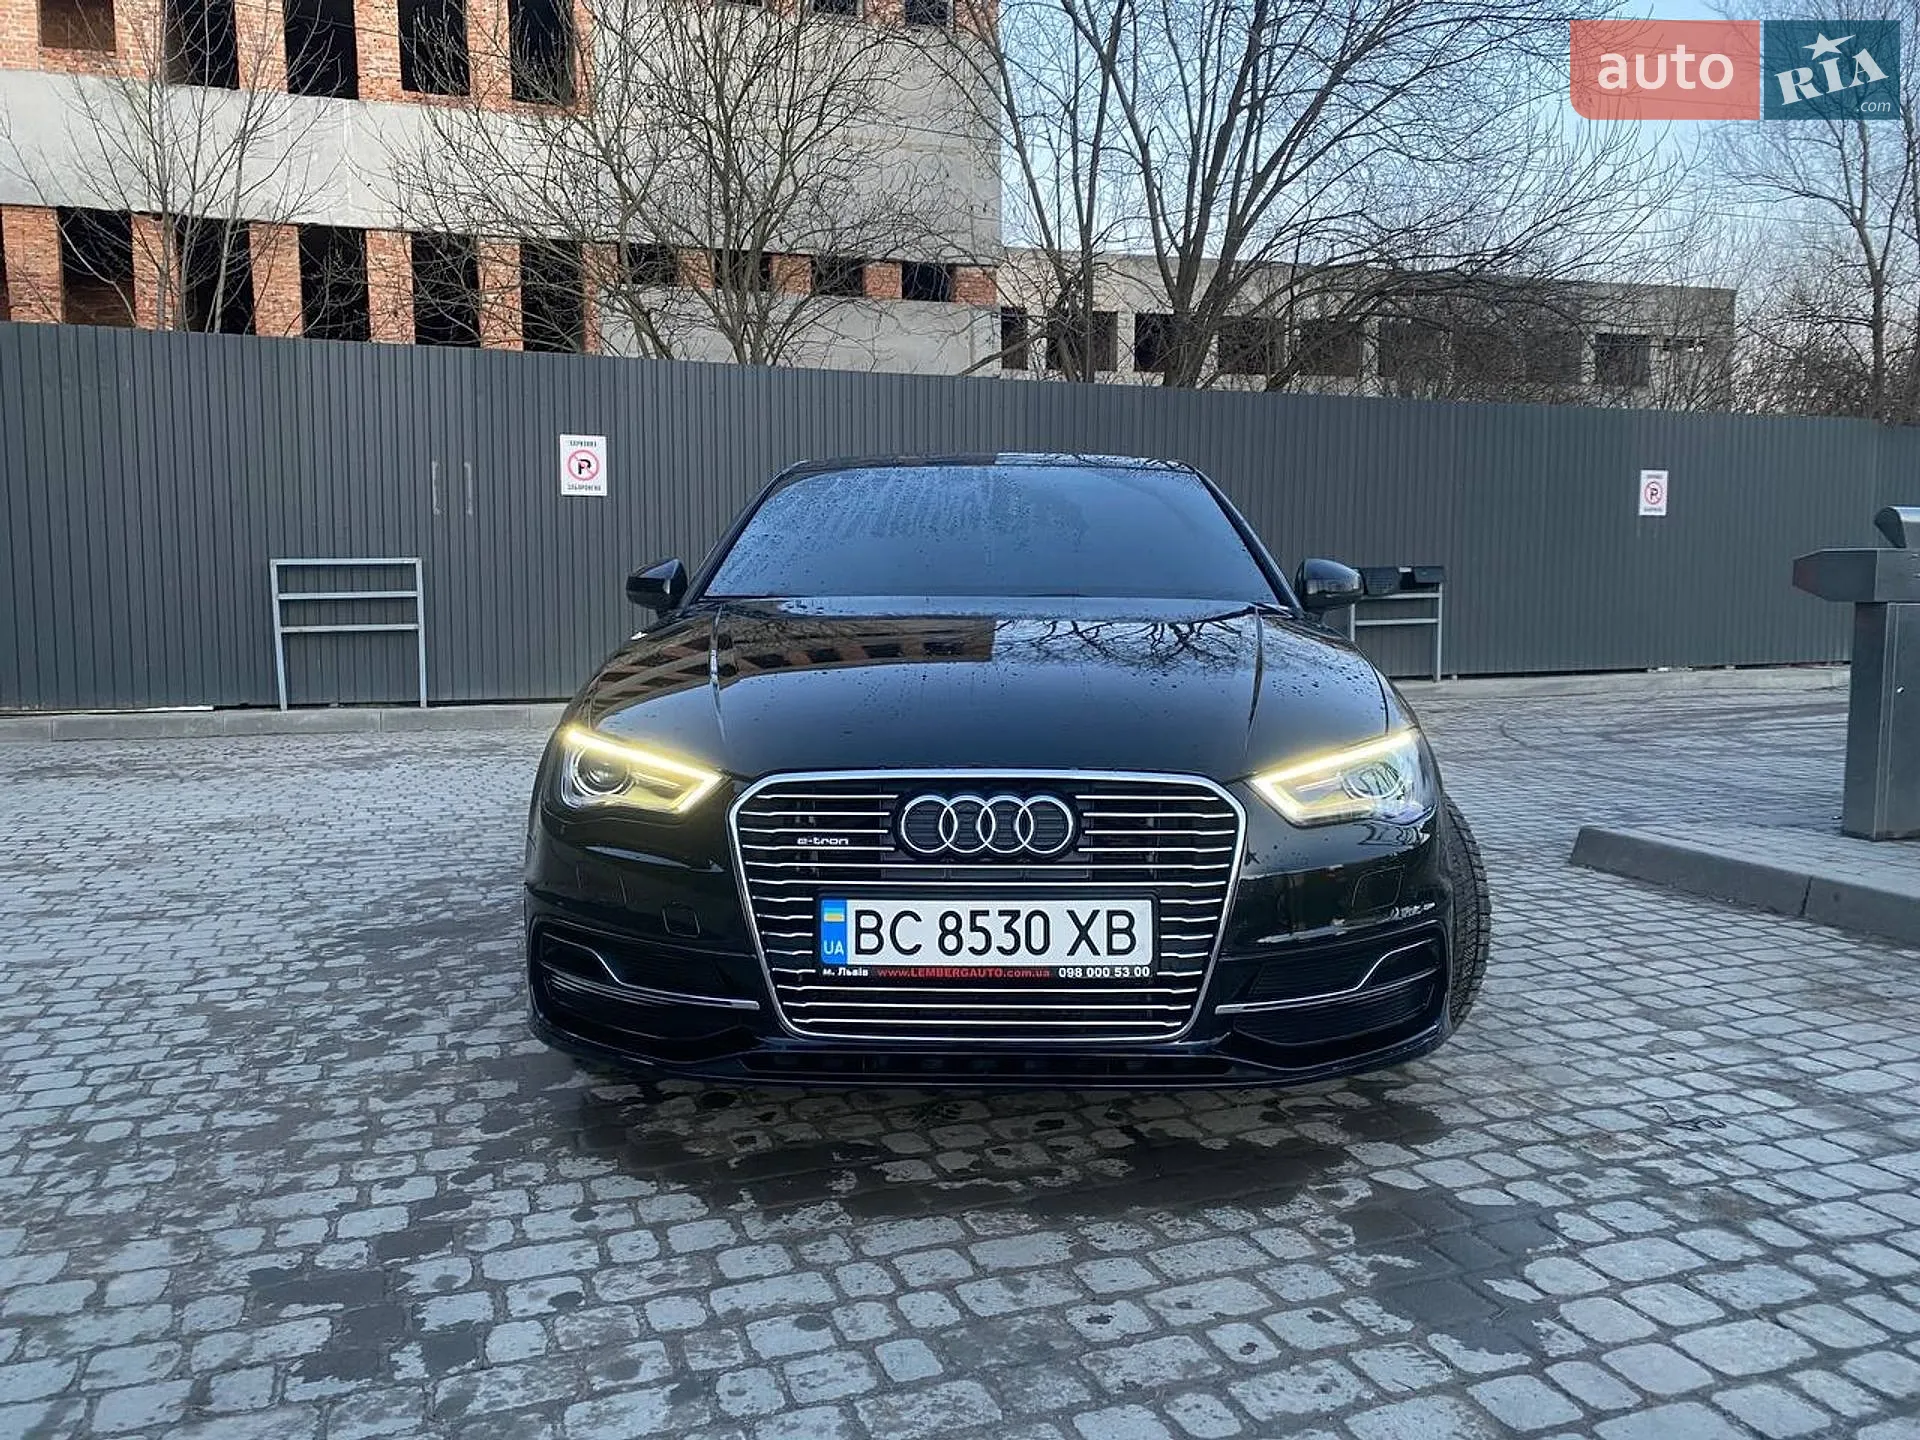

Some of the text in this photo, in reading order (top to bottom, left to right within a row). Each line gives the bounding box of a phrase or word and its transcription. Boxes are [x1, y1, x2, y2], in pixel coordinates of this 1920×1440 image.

[797, 837, 849, 845] e-tron
[855, 909, 1137, 957] BC 8530 XB
[823, 940, 845, 955] UA
[878, 967, 1050, 978] www.LEMBERGAUTO.com.ua
[1059, 966, 1150, 978] 098 000 53 00
